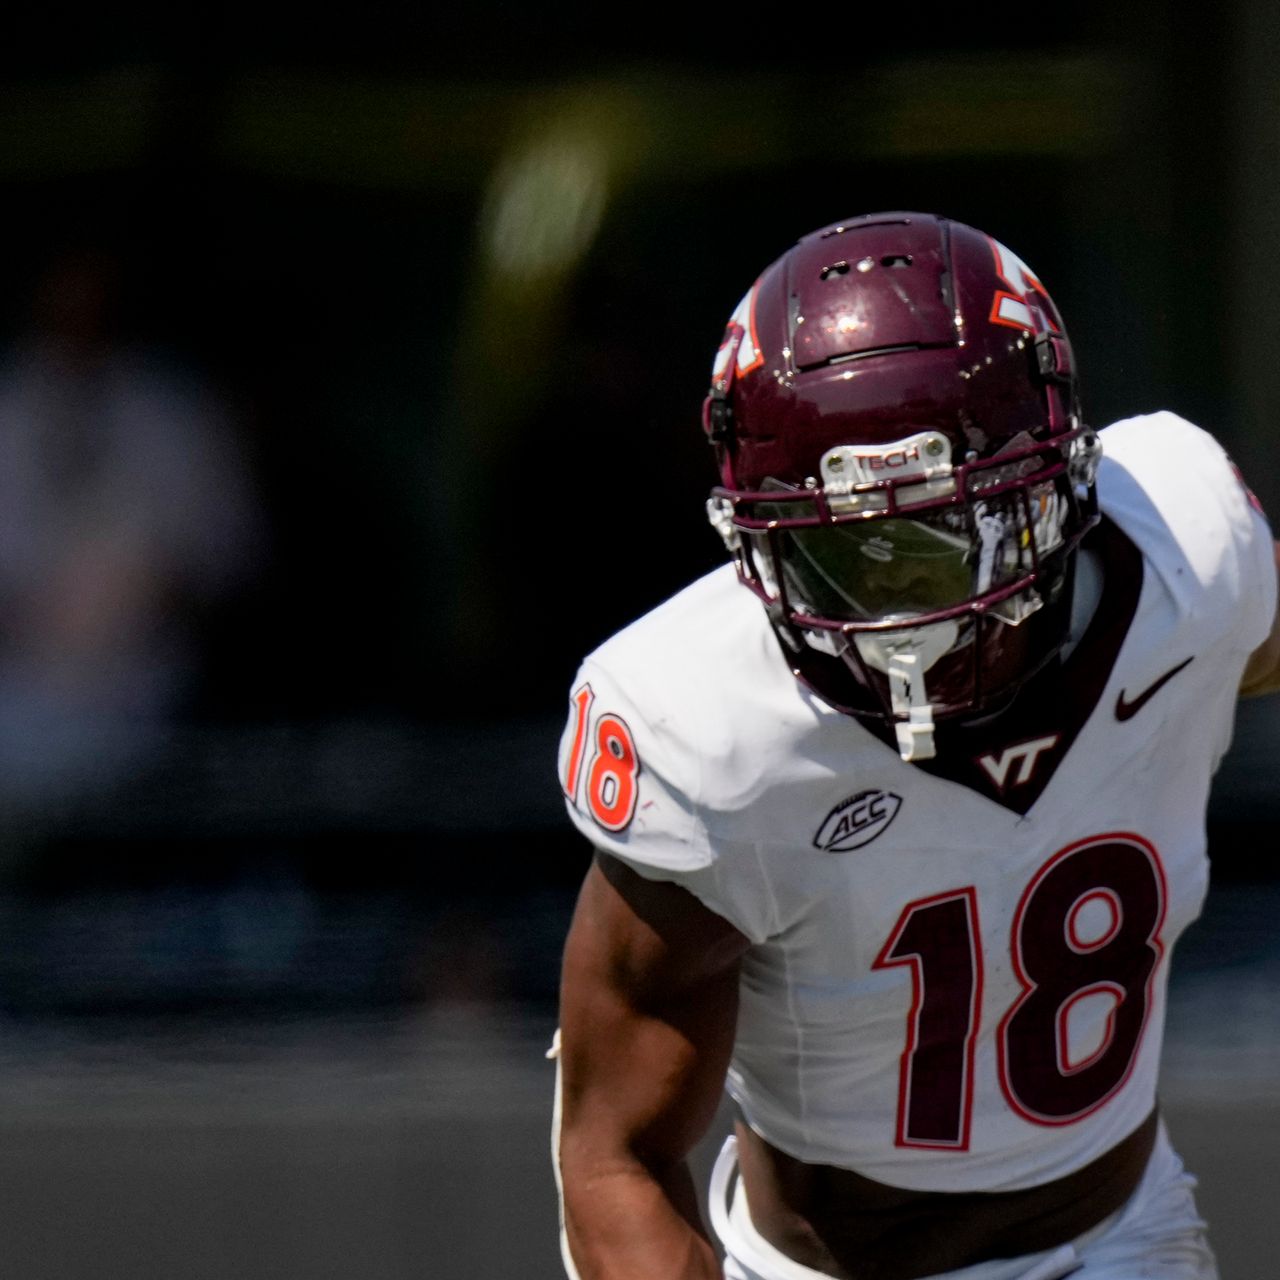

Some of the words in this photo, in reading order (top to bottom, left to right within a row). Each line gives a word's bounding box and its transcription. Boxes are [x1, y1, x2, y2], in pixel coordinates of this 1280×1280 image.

[853, 443, 919, 471] TECH
[562, 681, 642, 834] 18
[977, 733, 1060, 788] VT
[825, 793, 888, 849] ACC
[869, 831, 1168, 1152] 18
